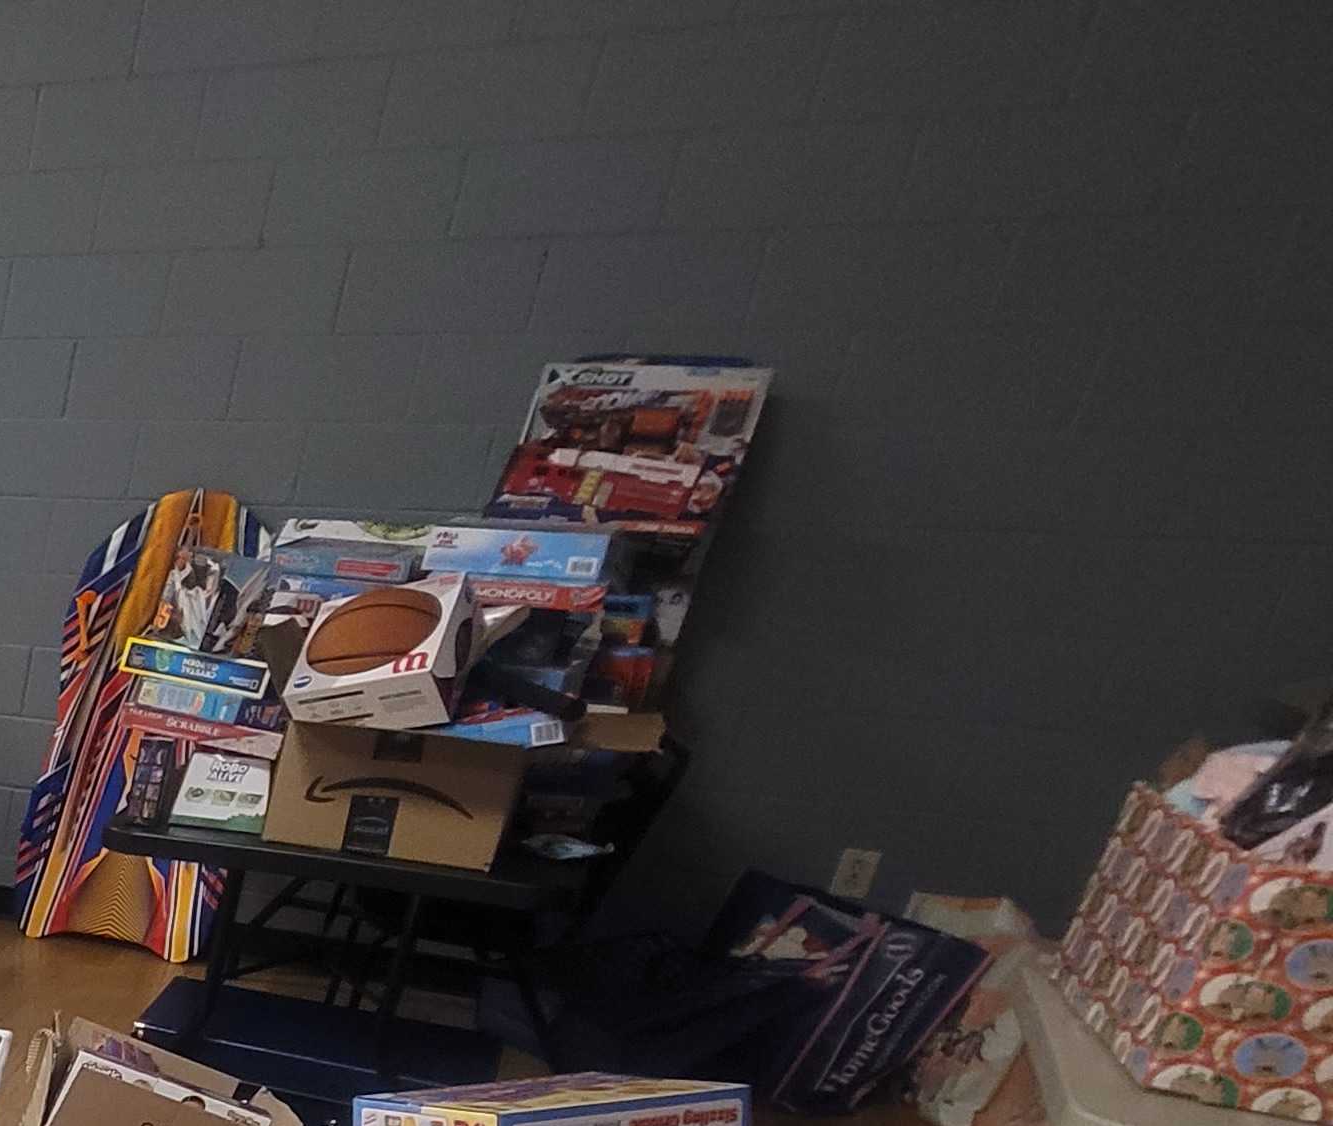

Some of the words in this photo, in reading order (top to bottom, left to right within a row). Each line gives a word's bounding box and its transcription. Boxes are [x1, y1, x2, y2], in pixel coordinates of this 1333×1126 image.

[477, 588, 553, 602] MONOPOLY
[166, 717, 220, 737] SCRABBLE
[210, 762, 250, 775] ROBO
[206, 772, 246, 784] ALIVE
